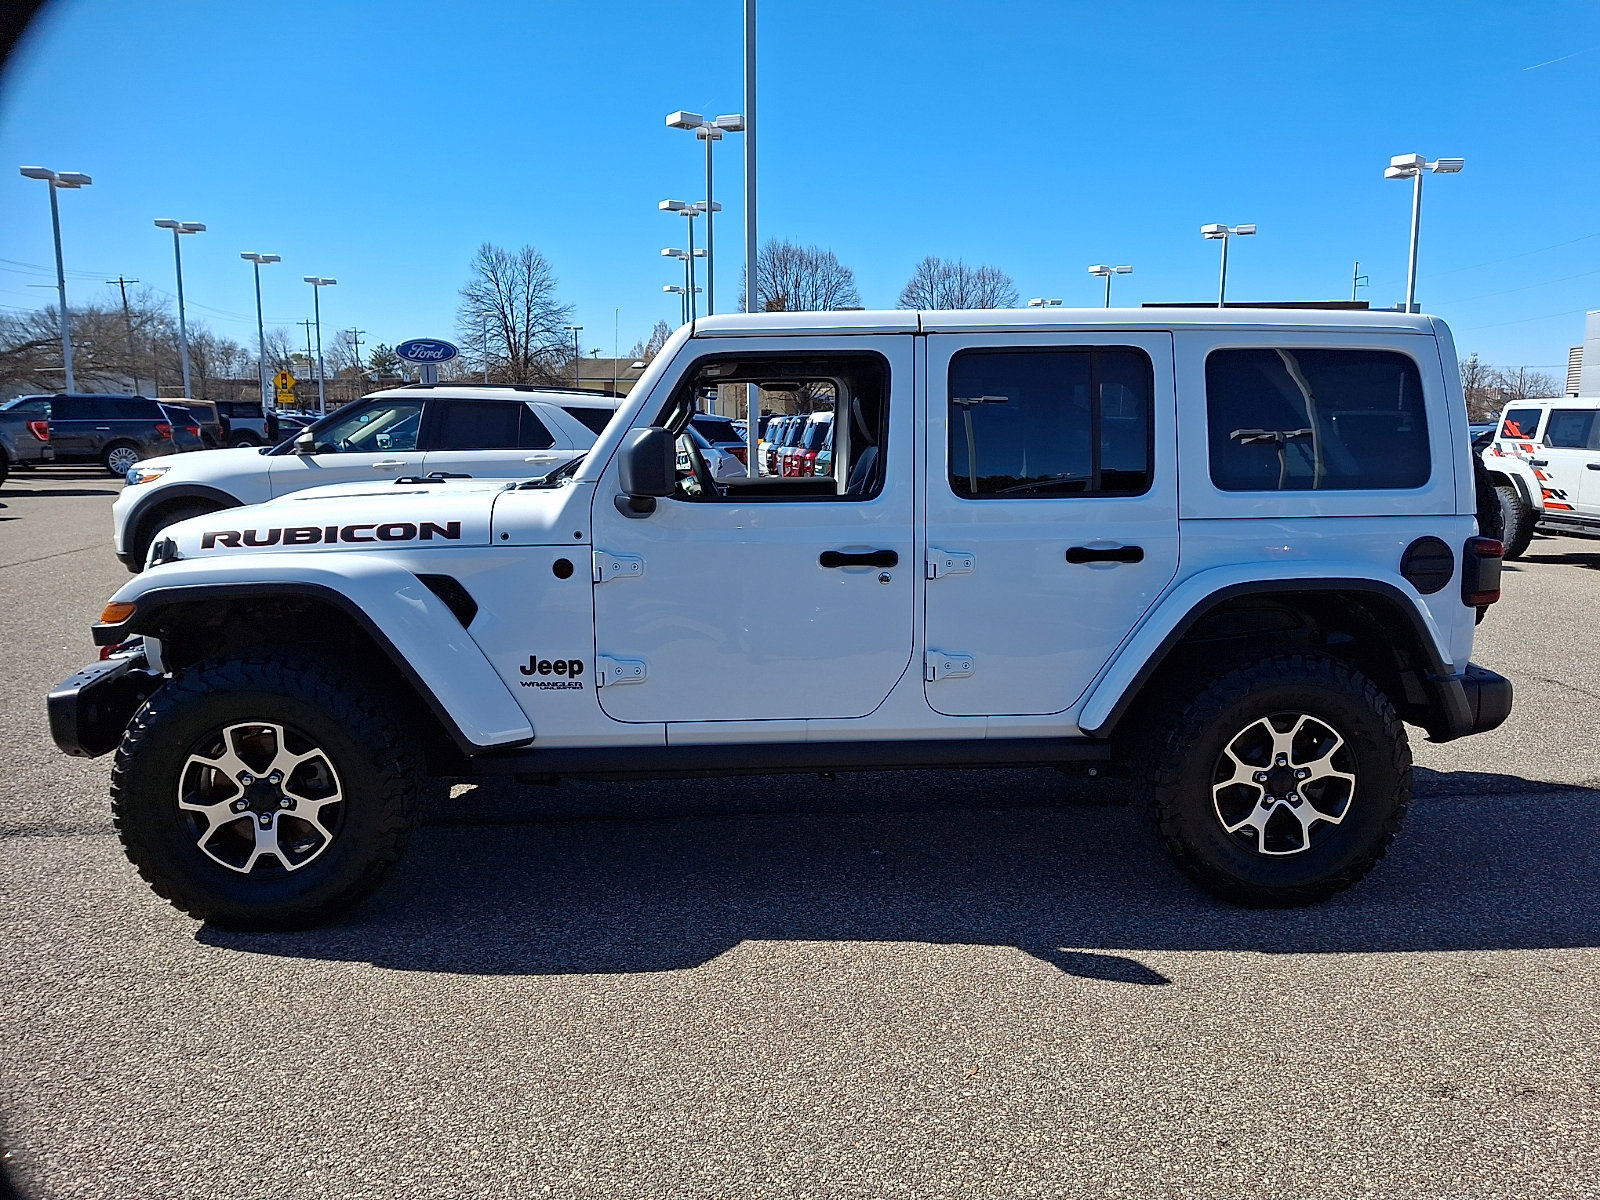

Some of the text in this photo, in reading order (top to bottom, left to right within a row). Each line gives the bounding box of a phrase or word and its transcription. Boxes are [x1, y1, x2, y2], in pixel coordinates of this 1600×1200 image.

[408, 343, 444, 359] Ford
[201, 521, 462, 550] RUBICON
[519, 655, 584, 679] Jeep
